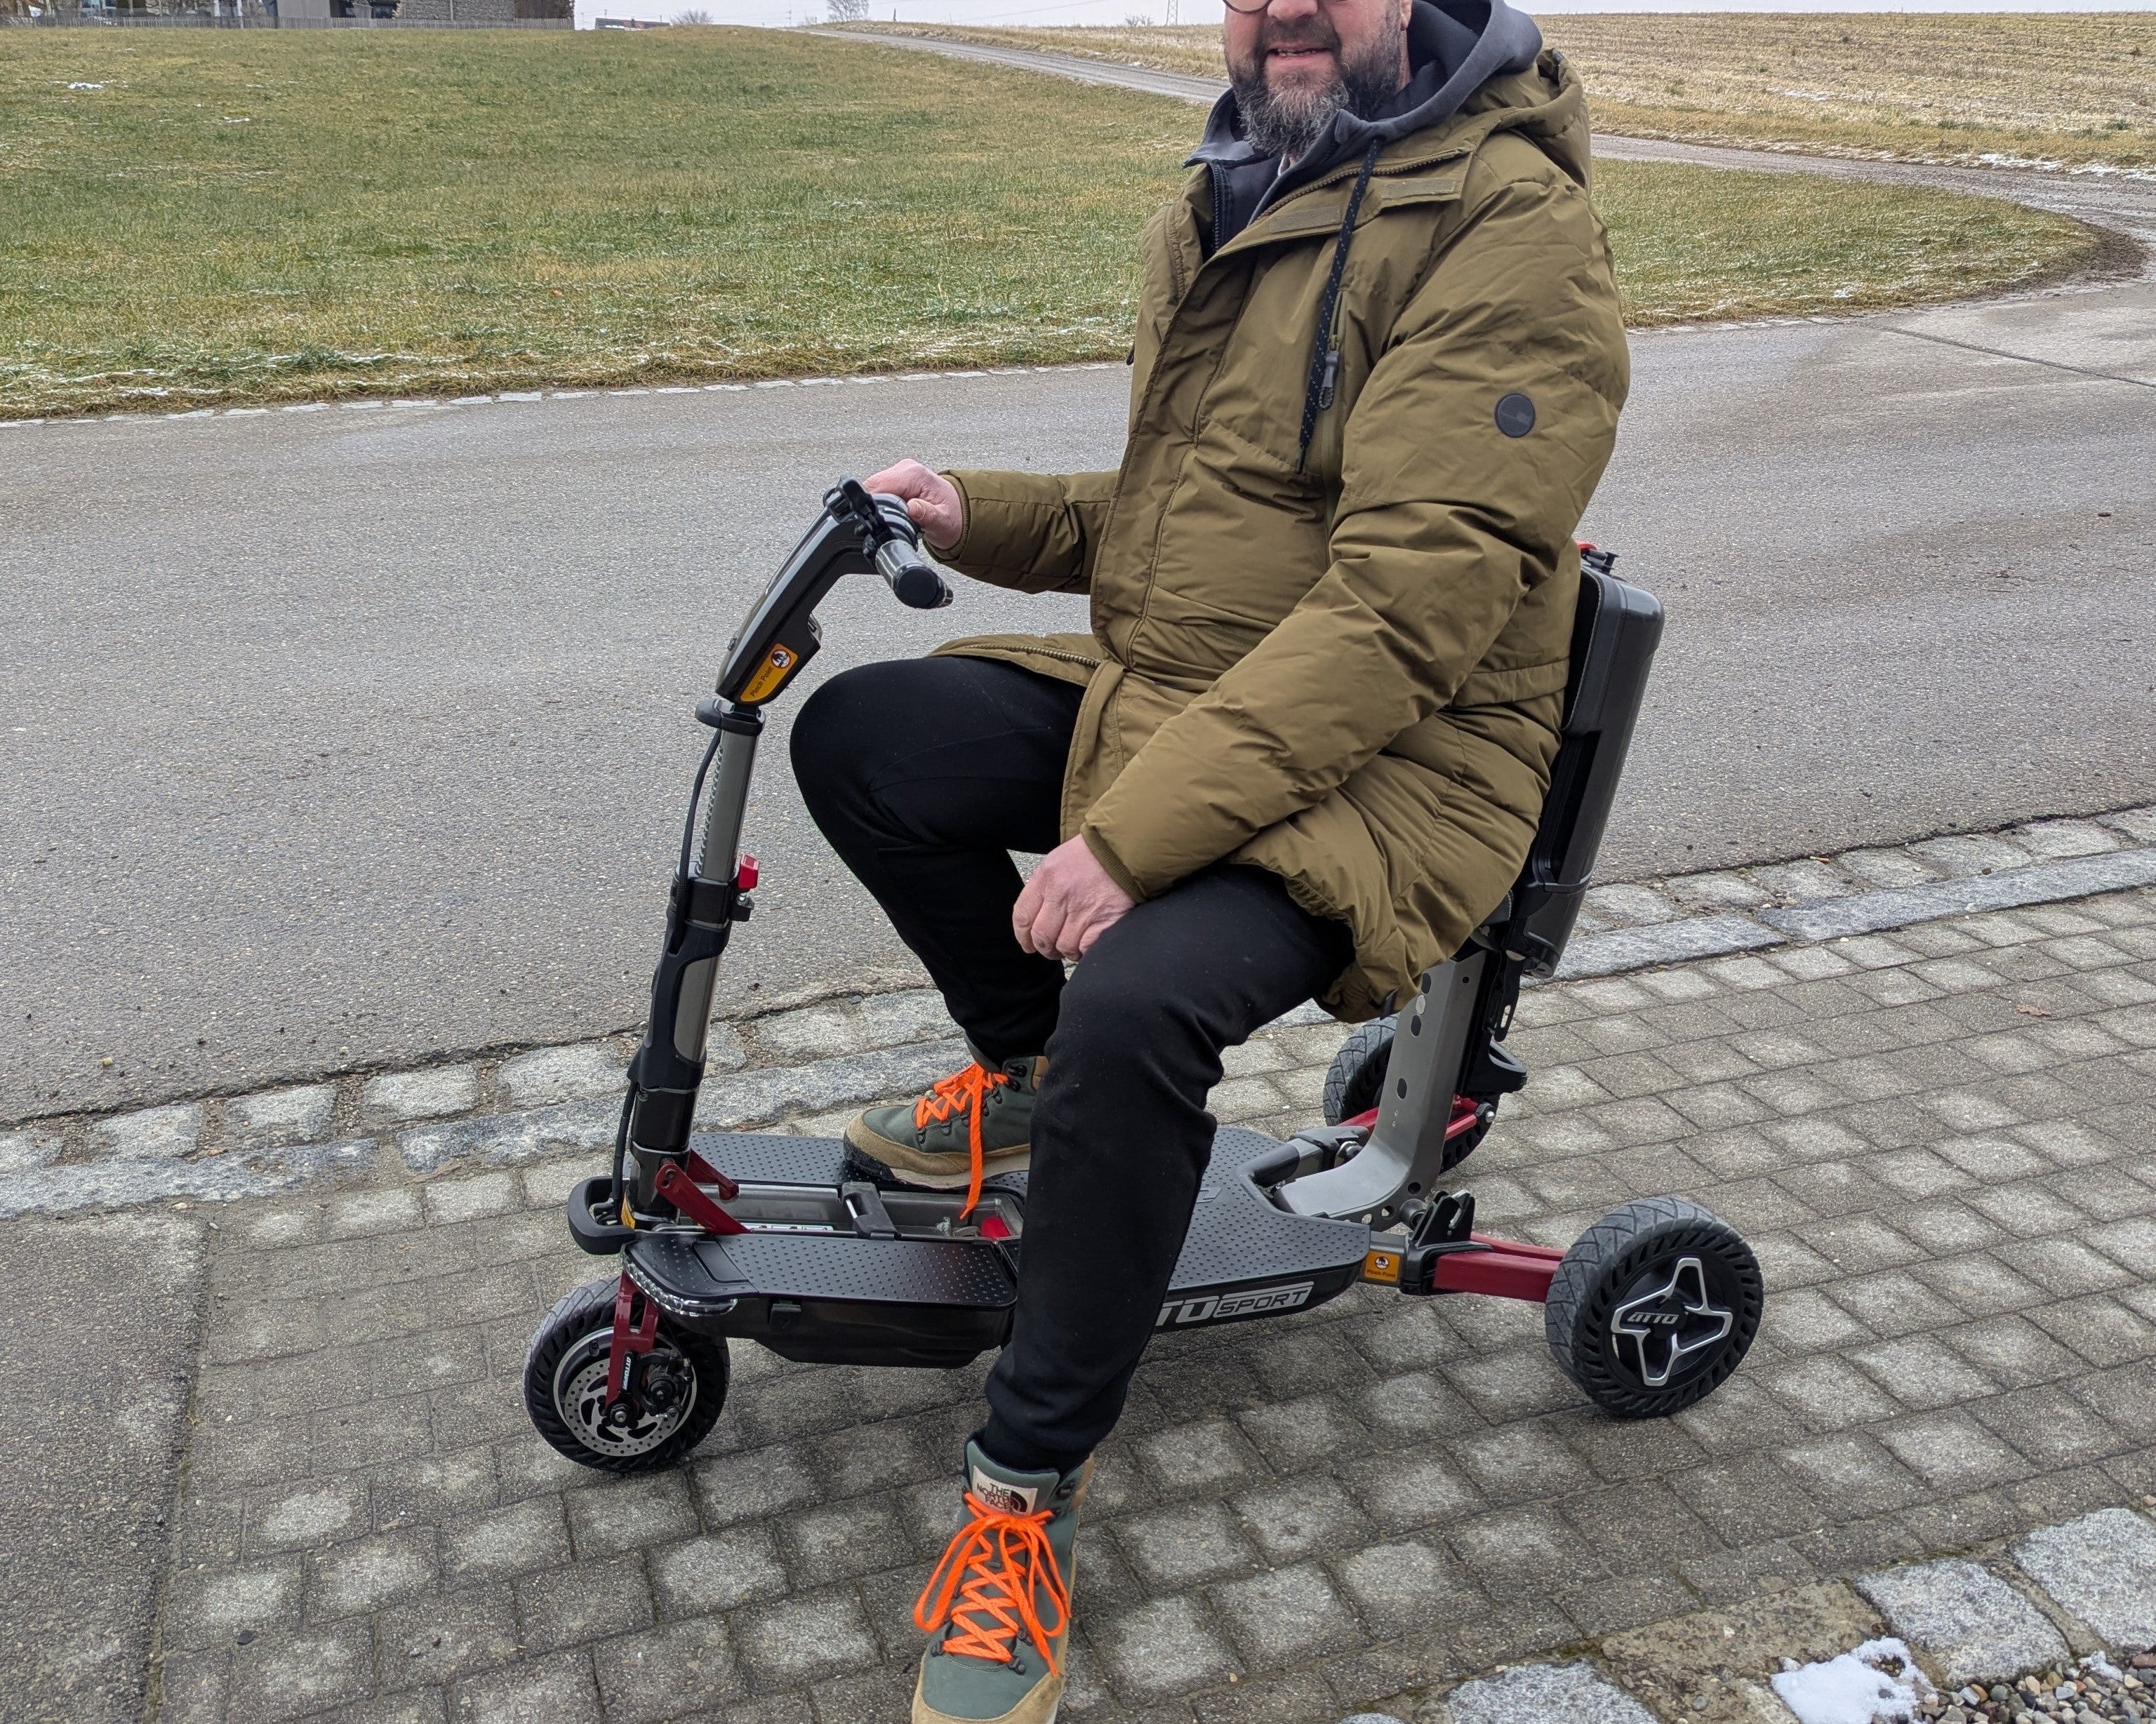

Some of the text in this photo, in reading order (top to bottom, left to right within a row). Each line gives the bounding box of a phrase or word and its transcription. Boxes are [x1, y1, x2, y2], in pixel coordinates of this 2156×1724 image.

[750, 681, 764, 697] Pinch
[1216, 1289, 1308, 1315] SPORT
[1628, 1311, 1679, 1325] ATTO
[976, 1483, 1009, 1502] NORTH
[990, 1483, 1009, 1496] THE
